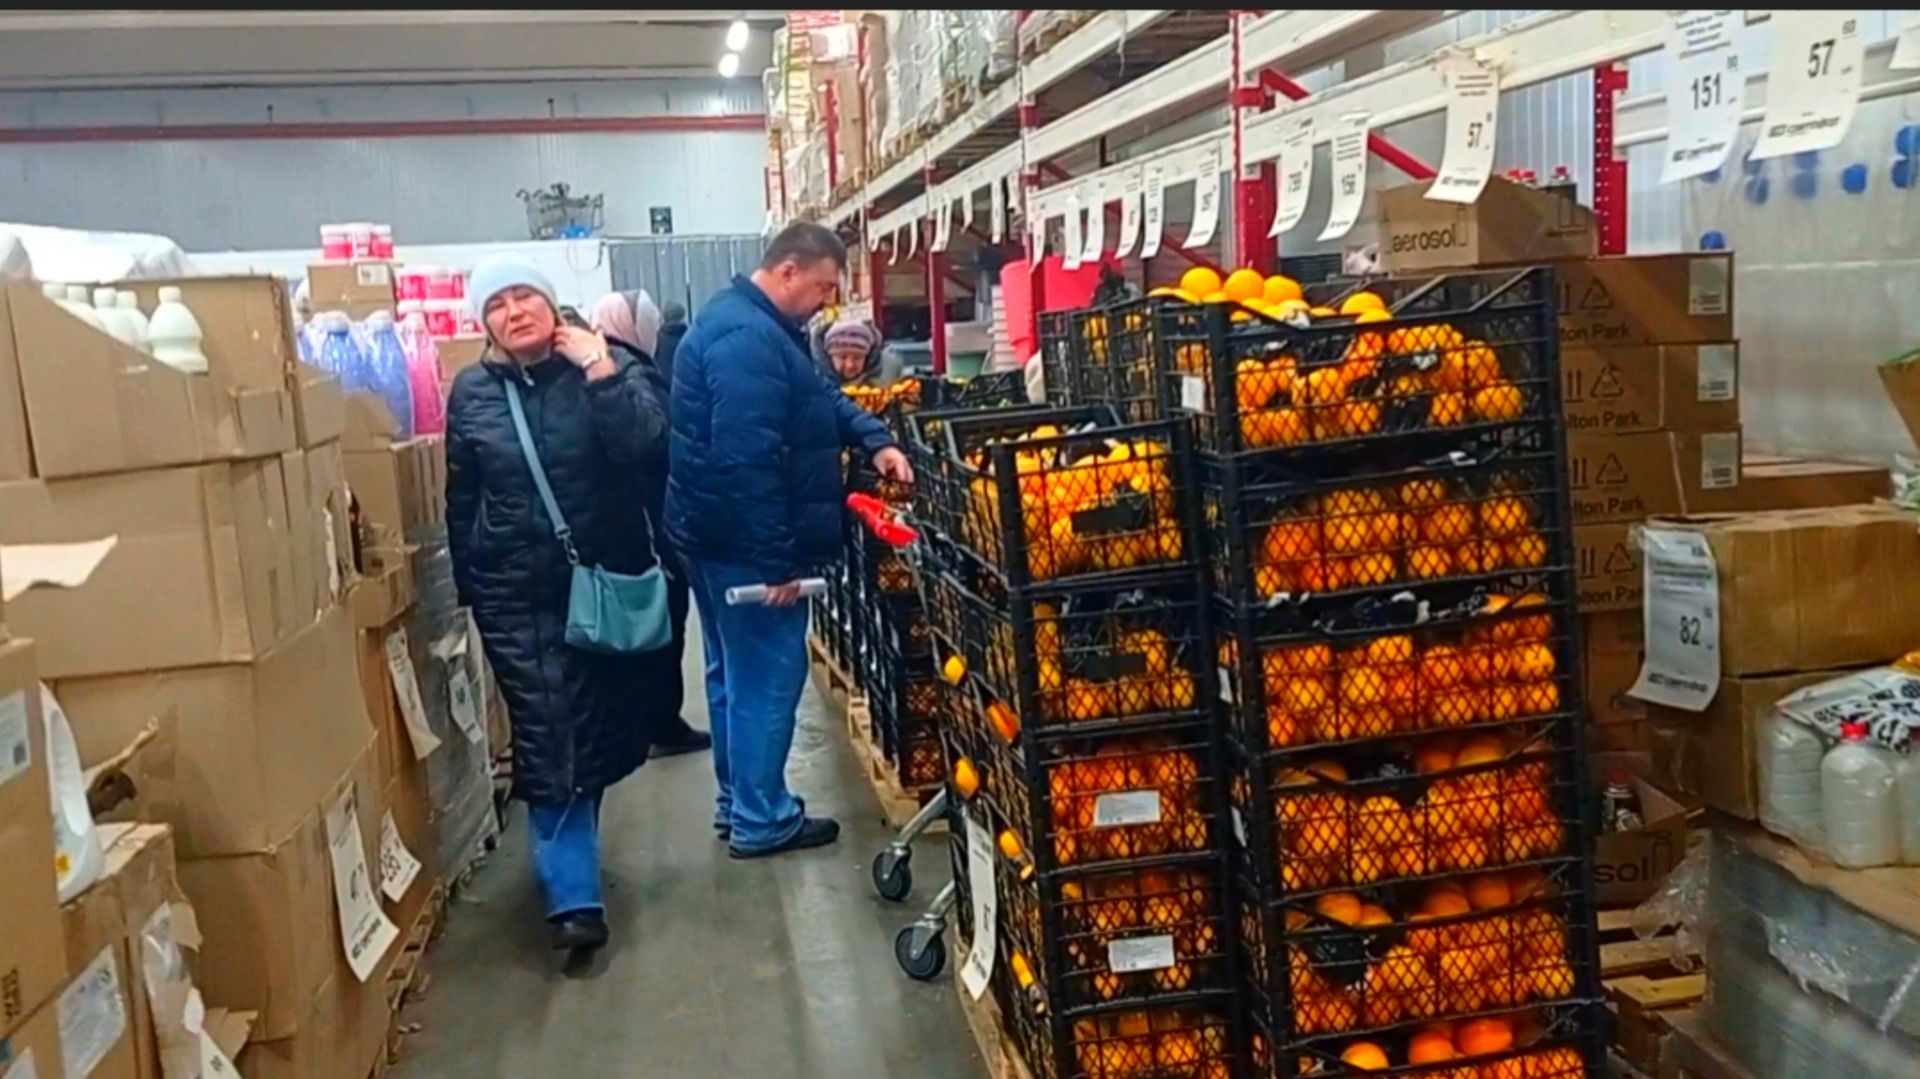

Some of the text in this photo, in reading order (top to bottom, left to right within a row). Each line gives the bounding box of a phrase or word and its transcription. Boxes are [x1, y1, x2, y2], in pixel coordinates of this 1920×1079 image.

[1807, 38, 1836, 78] 57
[1691, 71, 1722, 110] 151
[1467, 122, 1483, 149] 57
[1391, 222, 1456, 253] aerosol
[1591, 322, 1631, 340] Park
[1603, 409, 1641, 428] Park
[1608, 495, 1646, 513] Park
[1680, 616, 1701, 646] 82
